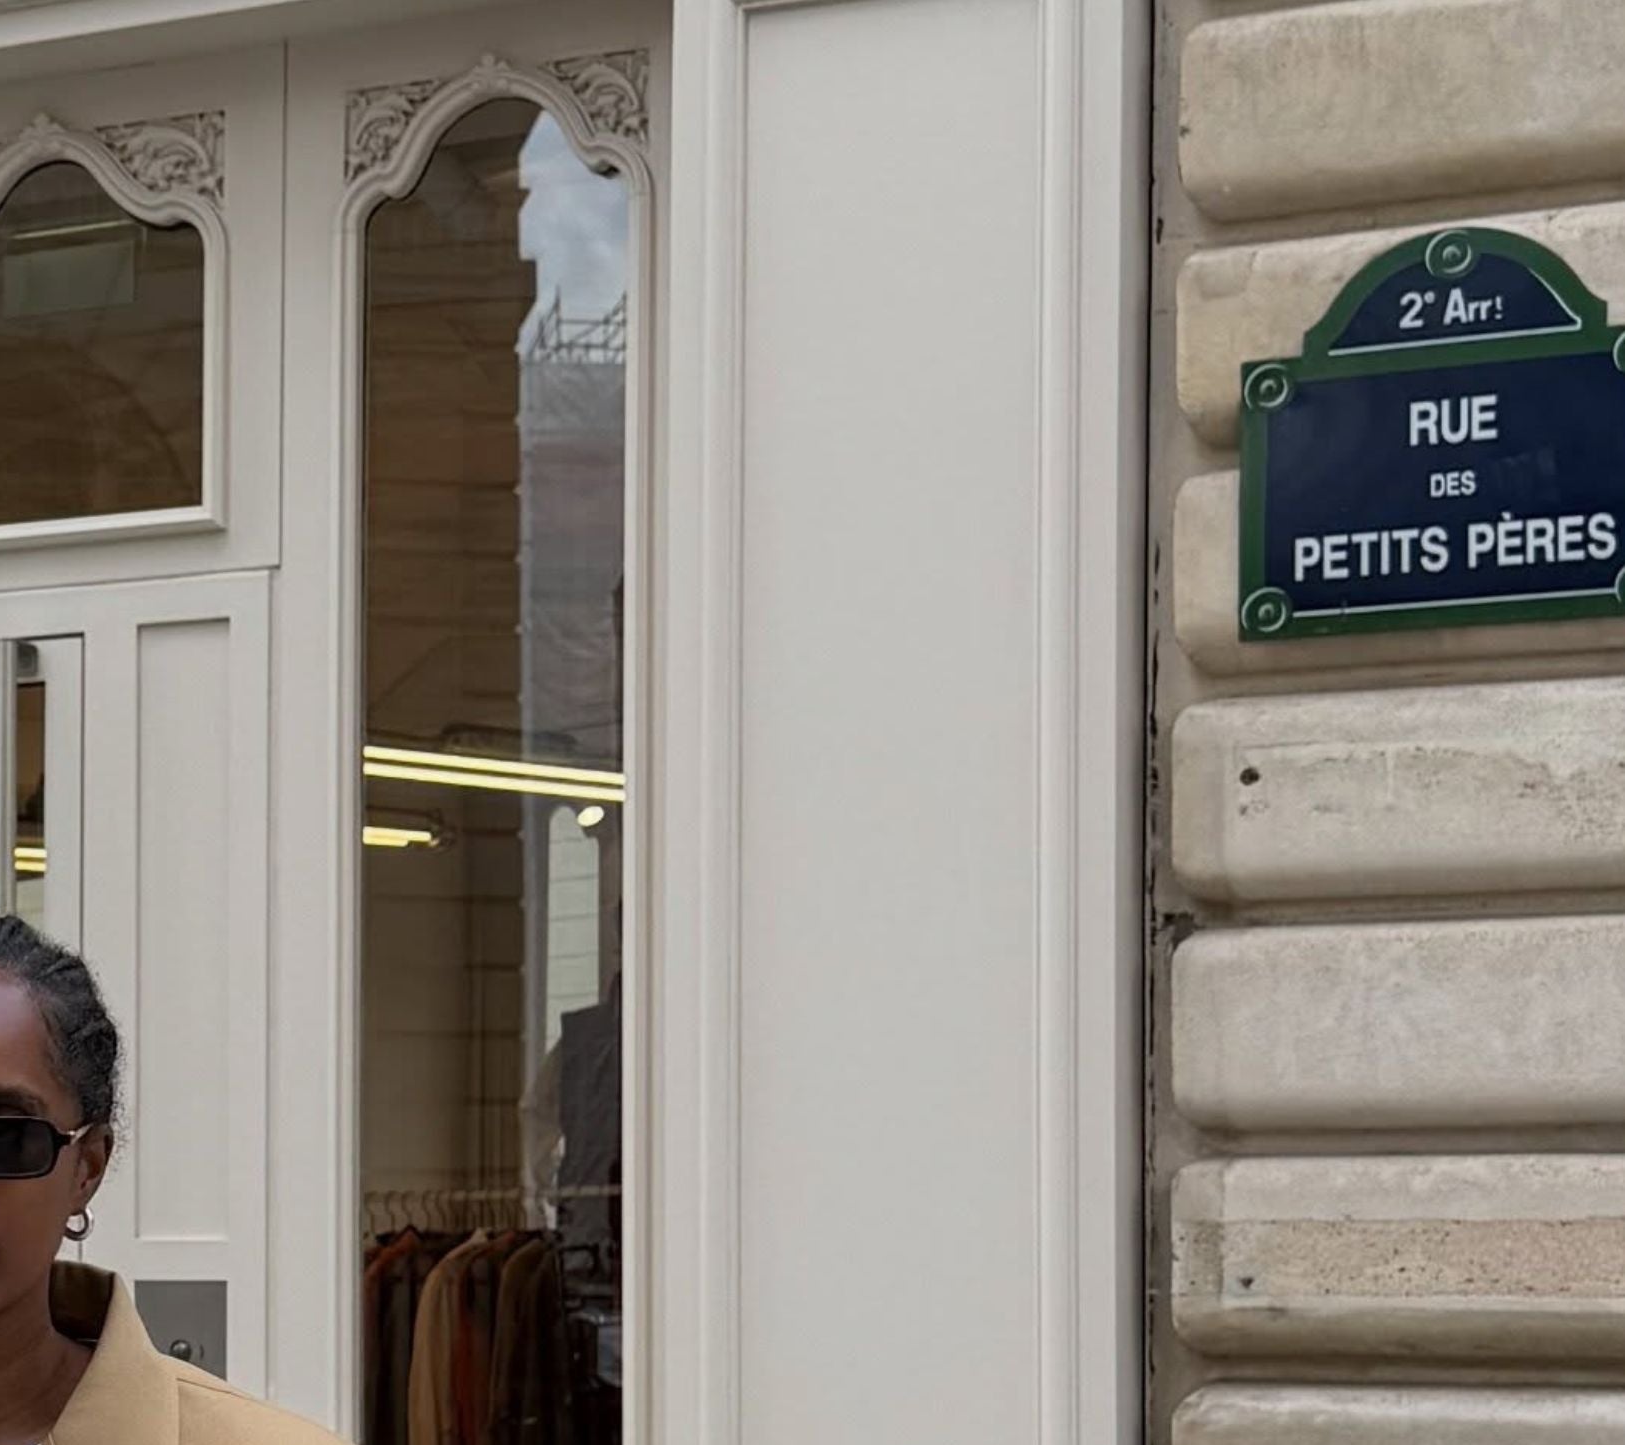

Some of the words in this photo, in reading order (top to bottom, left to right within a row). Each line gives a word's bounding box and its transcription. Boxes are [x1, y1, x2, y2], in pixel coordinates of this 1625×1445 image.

[1409, 394, 1498, 446] RUE
[1430, 470, 1476, 498] DES
[1294, 526, 1448, 581] PETITS
[1466, 511, 1616, 569] PÈRES
